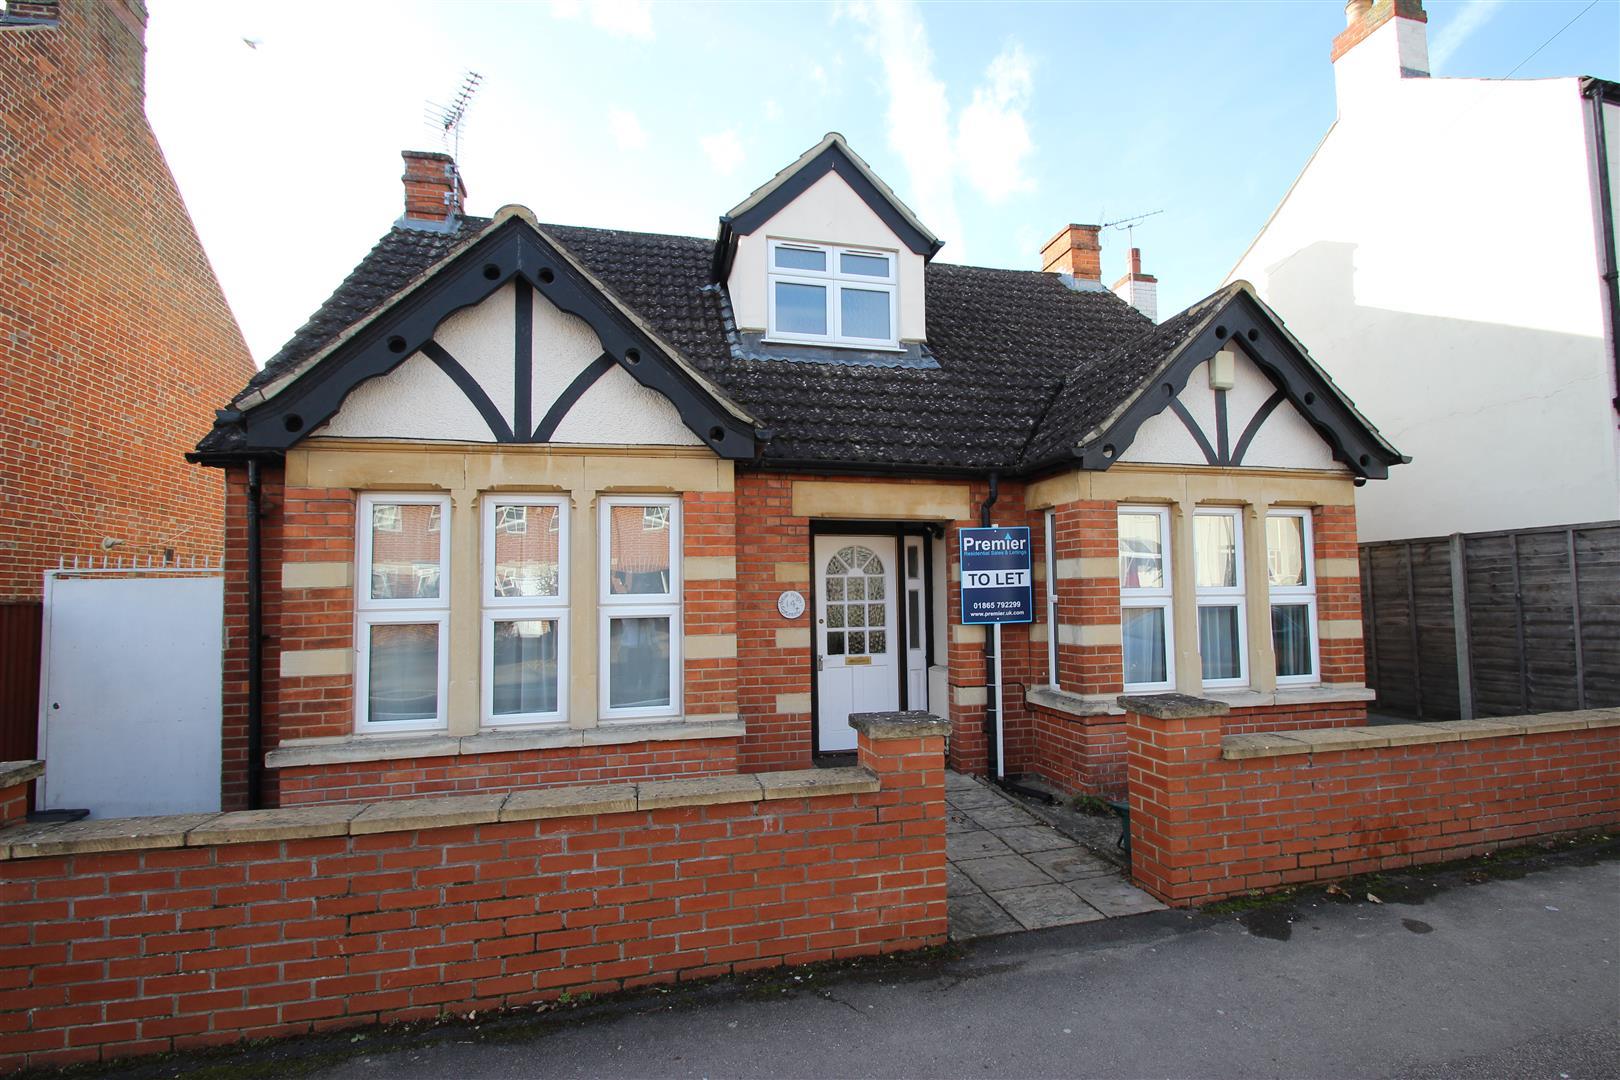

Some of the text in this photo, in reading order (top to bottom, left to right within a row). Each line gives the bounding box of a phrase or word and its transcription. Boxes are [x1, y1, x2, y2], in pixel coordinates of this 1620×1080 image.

[963, 537, 1026, 551] Premier
[968, 572, 1024, 586] TO LET
[996, 601, 1021, 609] 792299
[970, 610, 1025, 618] www.premier.uk.com
